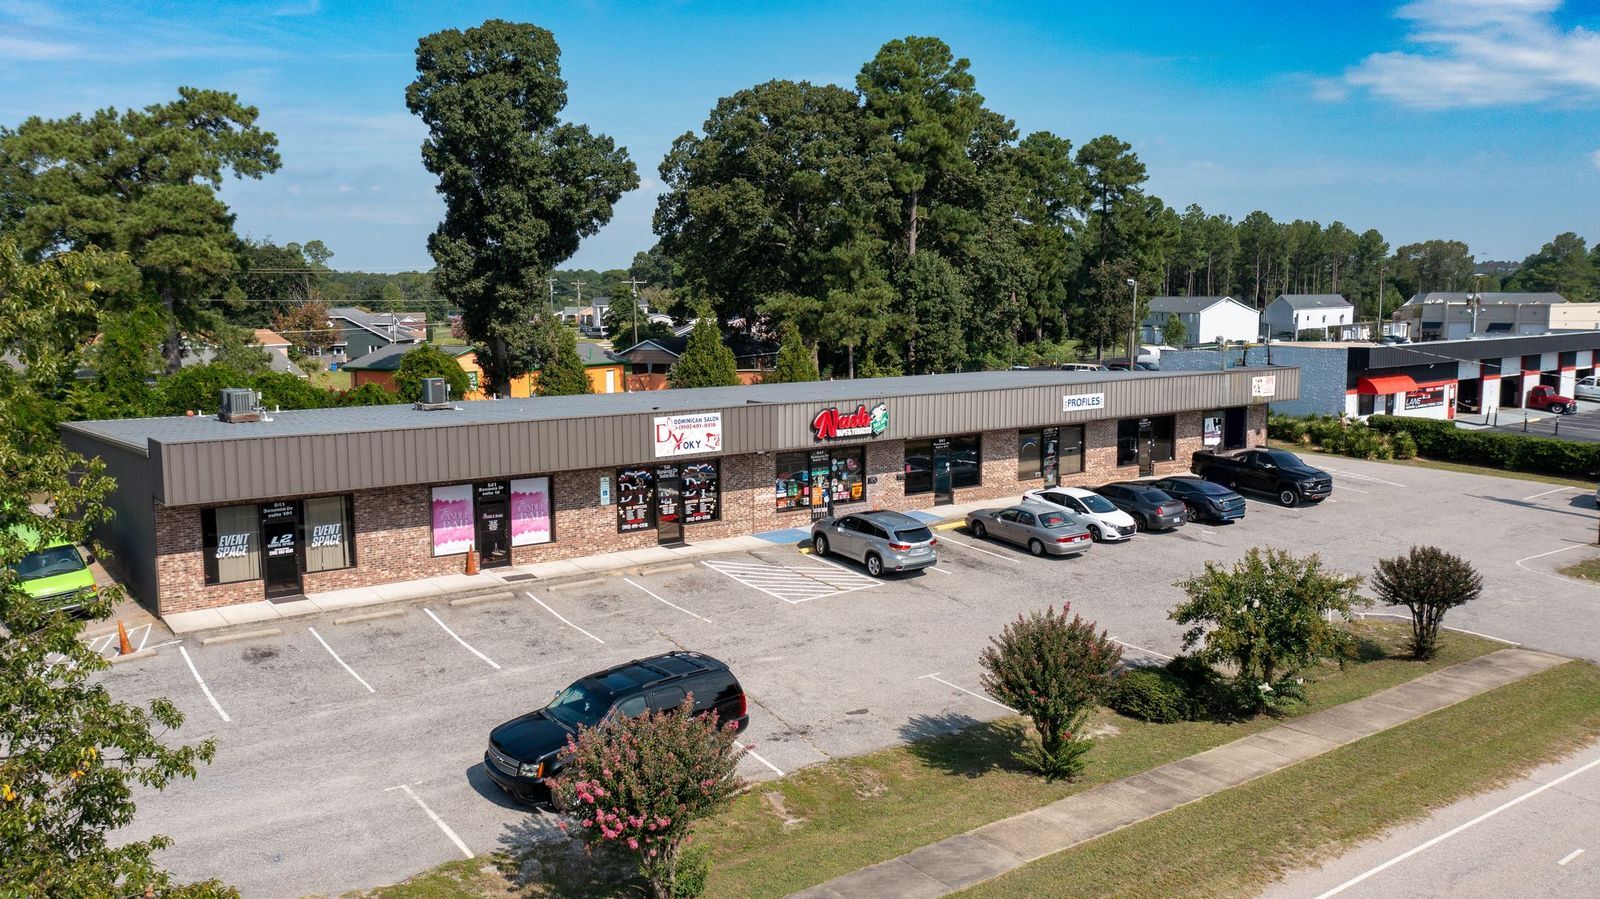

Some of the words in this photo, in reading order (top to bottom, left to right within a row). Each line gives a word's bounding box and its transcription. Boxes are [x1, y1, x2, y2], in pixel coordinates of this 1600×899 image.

[1067, 397, 1100, 407] PROFILES
[1406, 397, 1421, 406] LANE
[814, 405, 871, 439] Nash
[313, 523, 341, 536] EVENT
[219, 533, 250, 546] EVENT
[271, 533, 293, 545] L2
[311, 533, 342, 548] SPACE
[216, 544, 249, 558] SPACE
